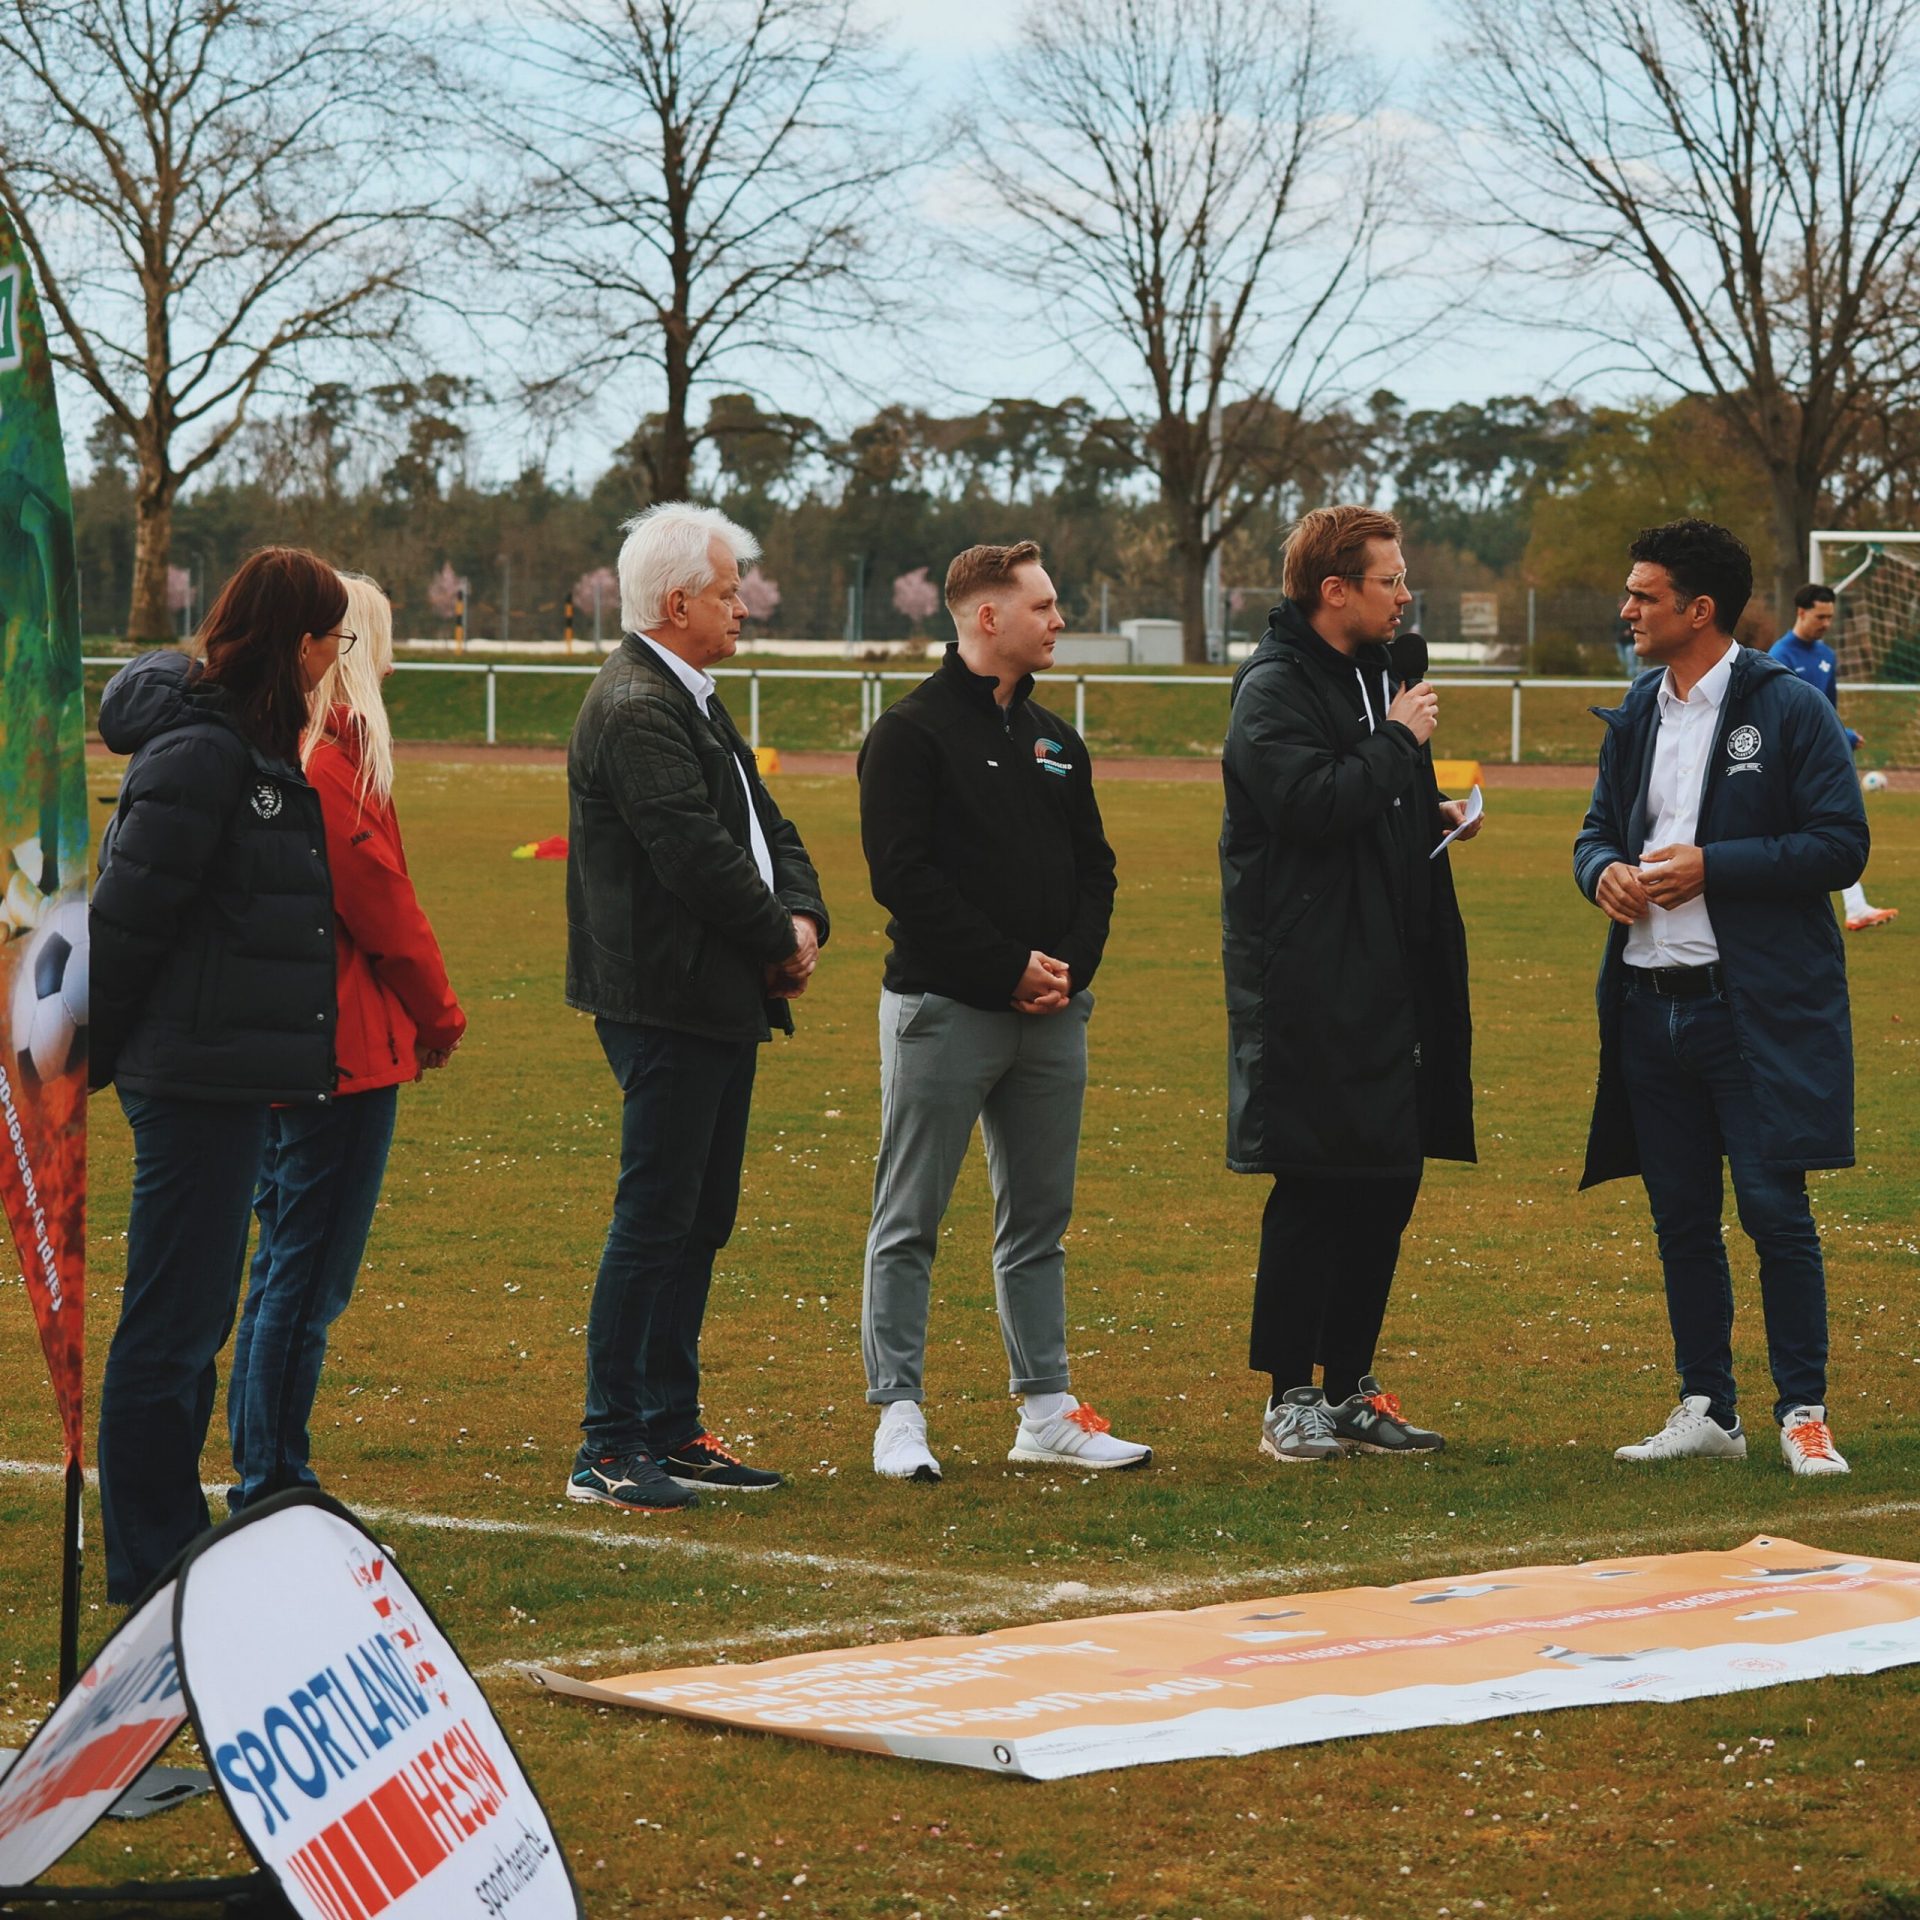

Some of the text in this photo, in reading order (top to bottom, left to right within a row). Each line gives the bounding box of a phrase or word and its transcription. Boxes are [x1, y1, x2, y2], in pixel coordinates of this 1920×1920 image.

[1352, 1410, 1377, 1430] N
[624, 1681, 740, 1702] MIT
[739, 1658, 919, 1690] JEDEM
[686, 1667, 1014, 1712] EIN ZEICHEN
[755, 1697, 942, 1723] GEGEN
[215, 1633, 430, 1836] SPORTLAND
